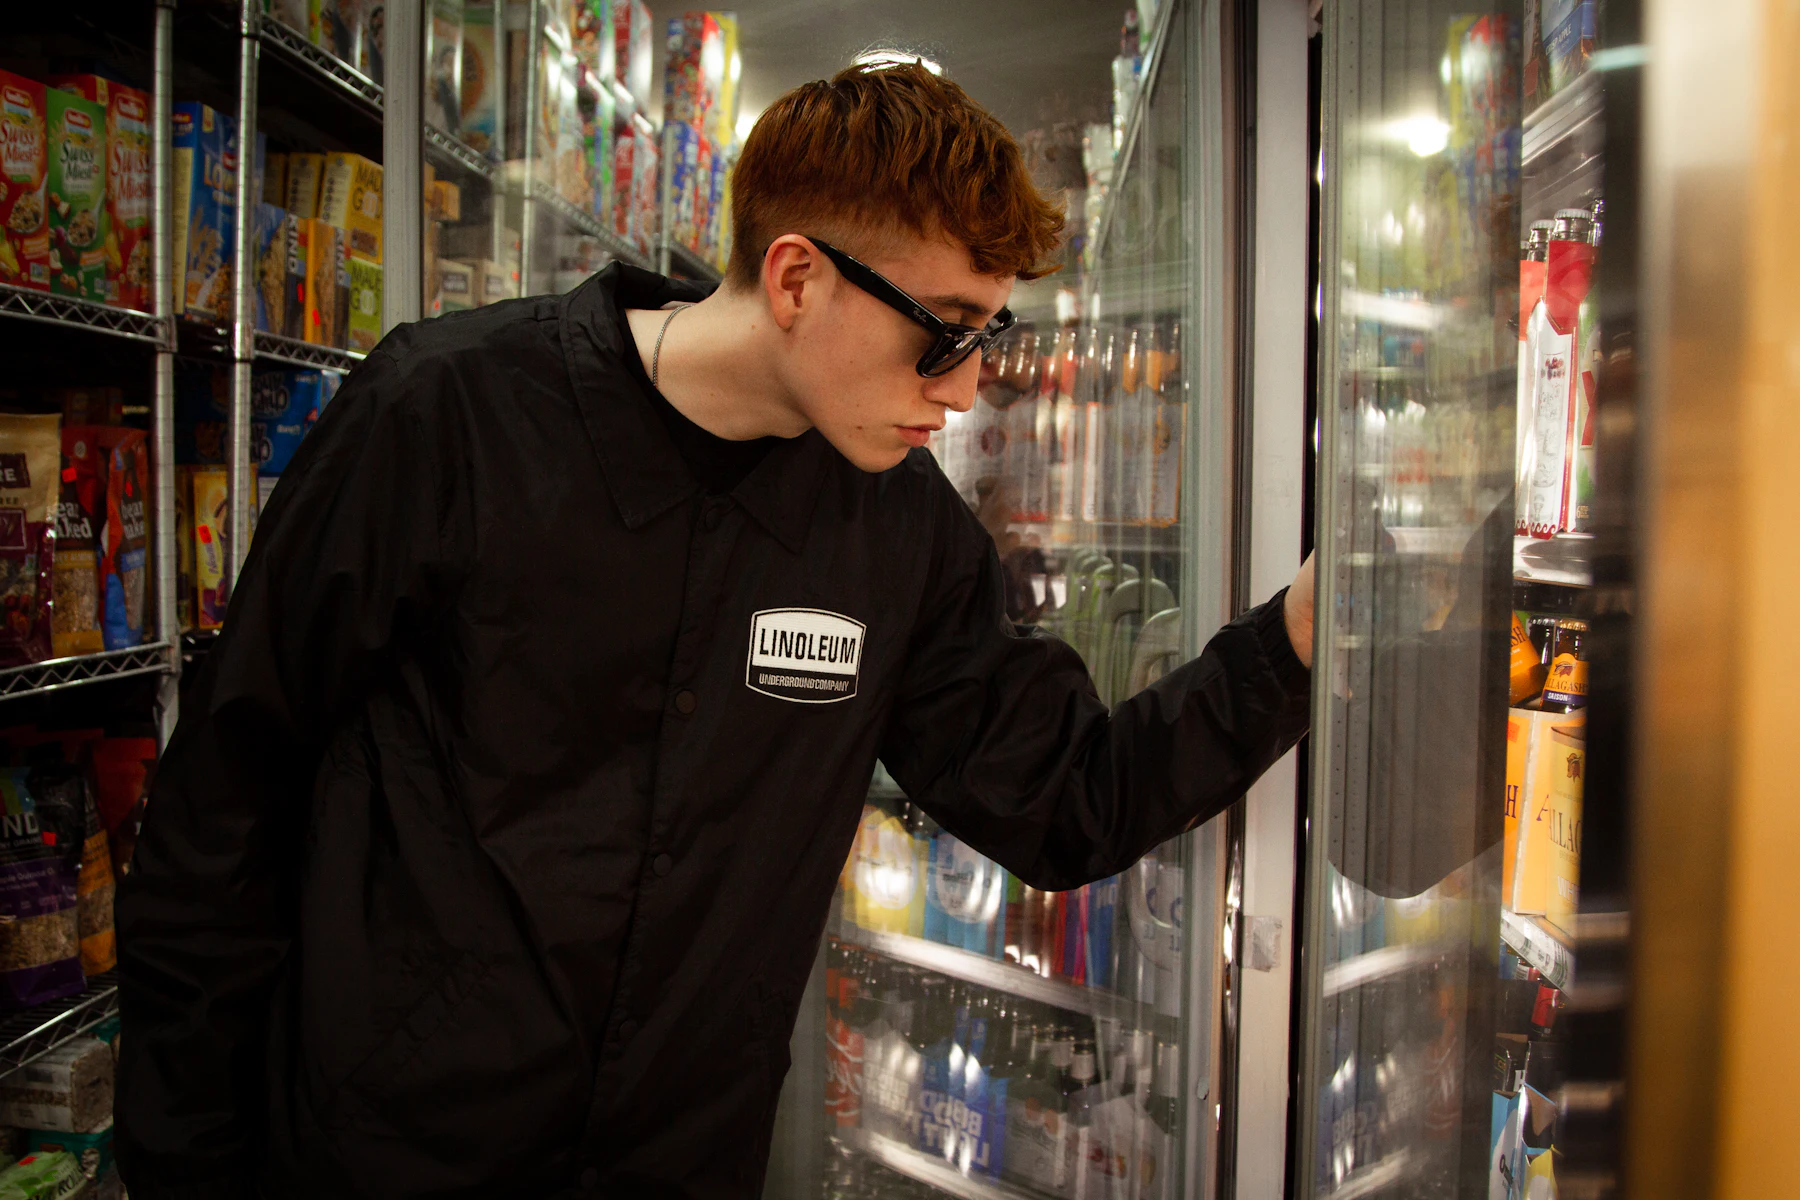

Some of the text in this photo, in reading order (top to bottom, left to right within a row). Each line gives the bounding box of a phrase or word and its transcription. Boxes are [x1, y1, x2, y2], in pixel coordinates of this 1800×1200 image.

[0, 119, 35, 146] Swiss
[60, 138, 94, 163] Swiss
[288, 213, 300, 275] KIND
[759, 628, 857, 664] LINOLEUM
[1547, 692, 1569, 702] SAISON
